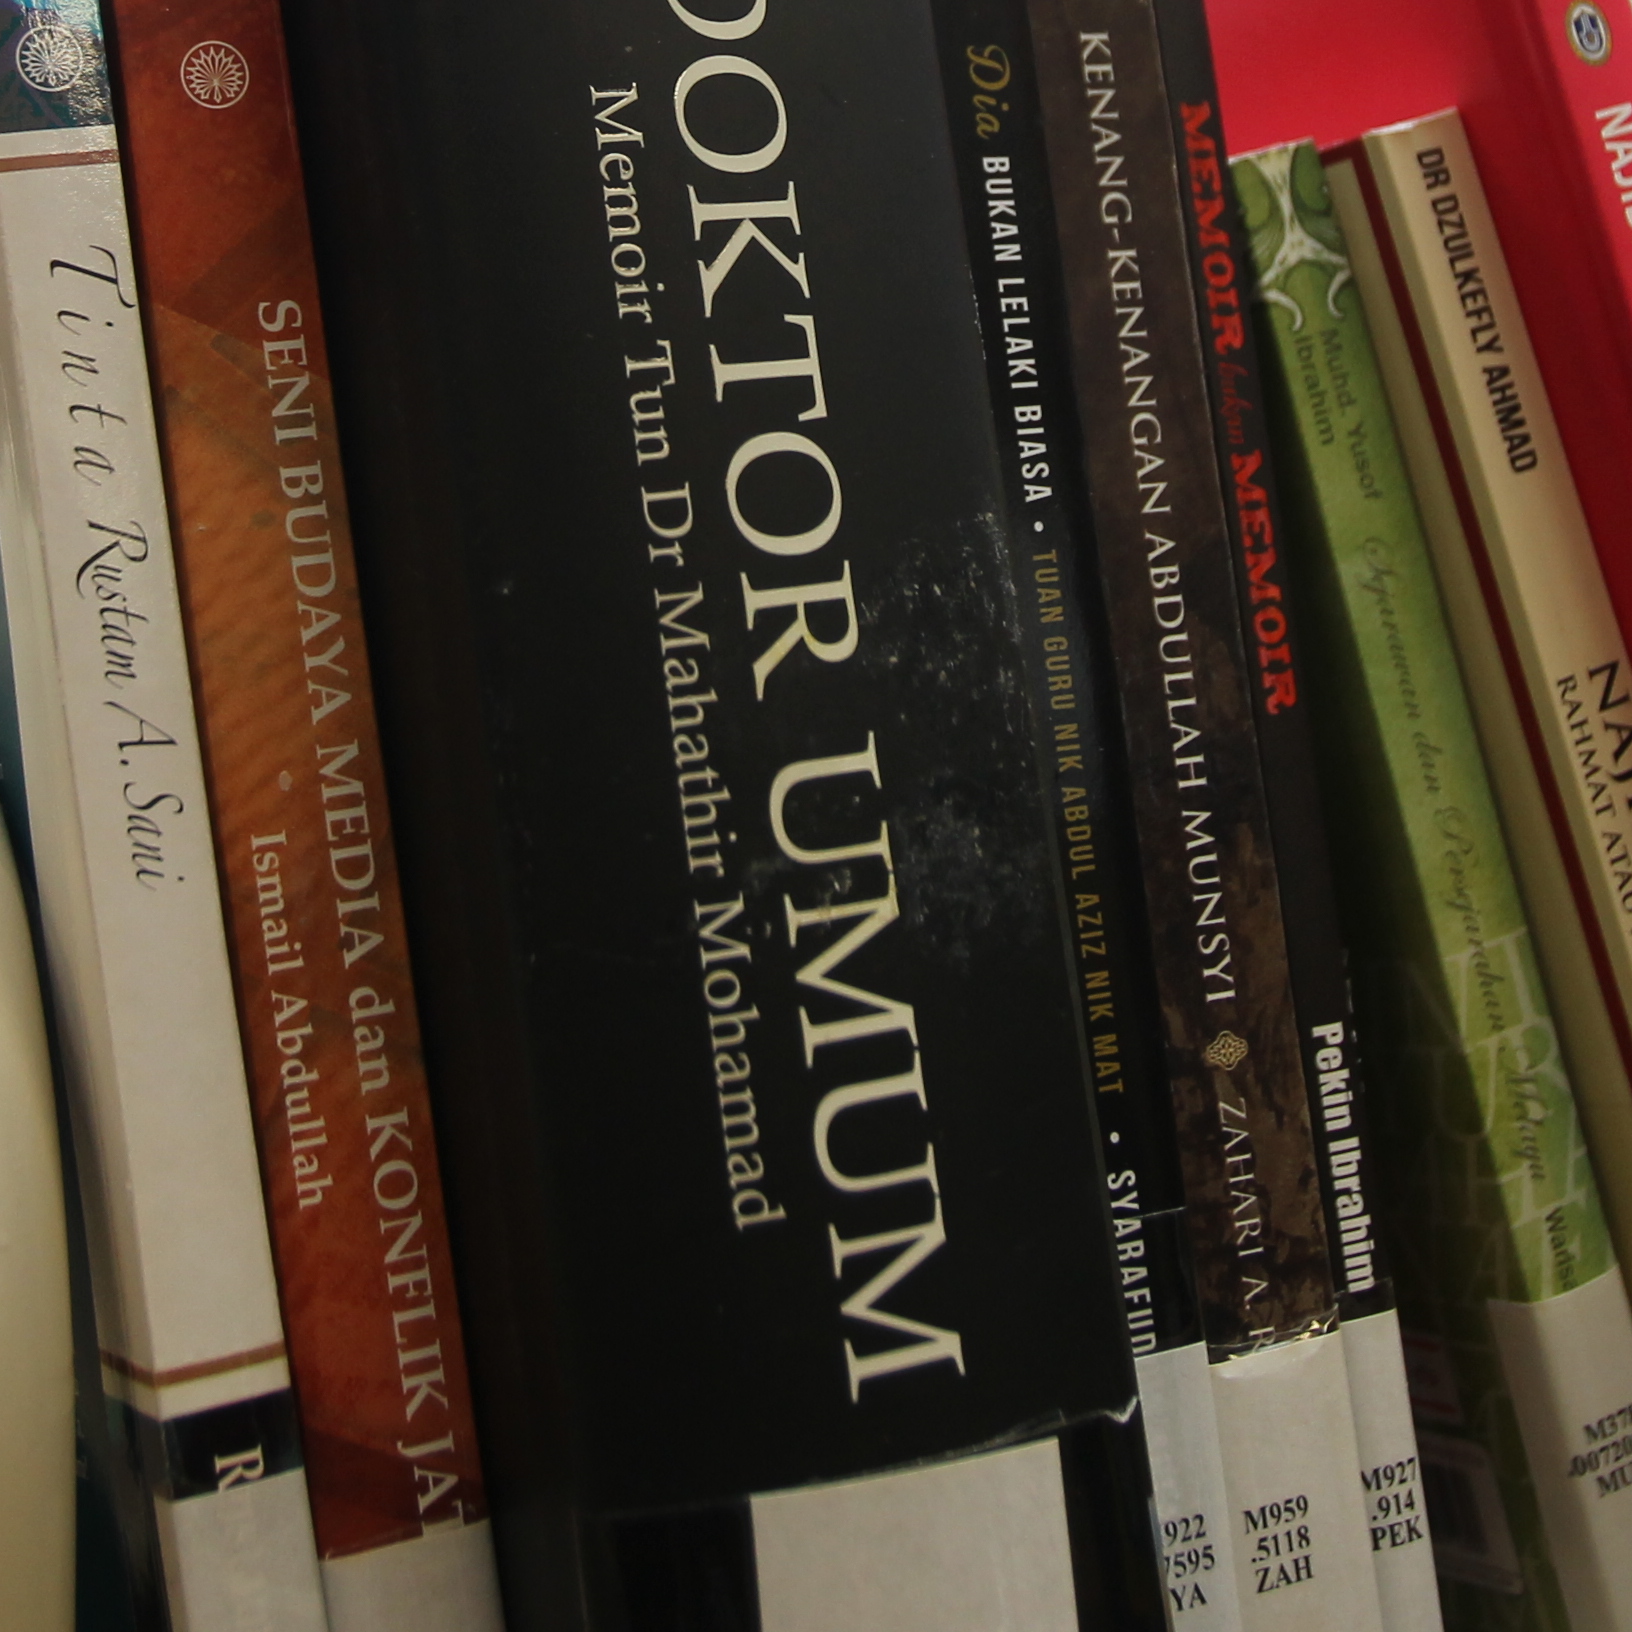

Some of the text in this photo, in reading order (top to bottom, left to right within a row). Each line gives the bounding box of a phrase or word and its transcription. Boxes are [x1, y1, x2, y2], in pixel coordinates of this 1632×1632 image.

[257, 299, 317, 442] SENI
[968, 45, 1052, 504] Dia BUKAN LELAKI BIASA
[1417, 148, 1538, 475] DR DZULKEFLY AHMAD
[1180, 101, 1245, 355] MEMOIR
[1231, 450, 1297, 715] MEMOIR
[1294, 335, 1333, 447] Ibrahim
[50, 245, 185, 893] Tinta Rustam A. Sani
[279, 460, 349, 727] BUDAYA
[1079, 31, 1236, 1002] KENANG-KENANGAN ABDULLAH MUNSYI
[590, 82, 786, 1233] Memoir Tun Dr Mahathir Mohamad
[1557, 674, 1617, 817] RAHMAT
[316, 739, 386, 970] MEDIA
[1033, 549, 1124, 1093] TUAN GURU NIK ABDUL AZIZ NIK MAT
[250, 830, 333, 1210] Ismail Abdullah
[347, 984, 393, 1096] dan
[768, 731, 965, 1404] UMUM
[365, 1107, 450, 1425] KONFLIK
[1218, 1097, 1264, 1258] ZAHARI
[1242, 1276, 1269, 1311] A.
[1311, 1021, 1376, 1293] Pekin Ibrahim
[1162, 1514, 1207, 1544] 922
[1243, 1494, 1310, 1535] M959
[1251, 1525, 1311, 1564] .5118
[1255, 1554, 1315, 1595] ZAH
[1361, 1456, 1418, 1492] M927
[1370, 1515, 1424, 1552] PEK
[1371, 1489, 1416, 1522] .914
